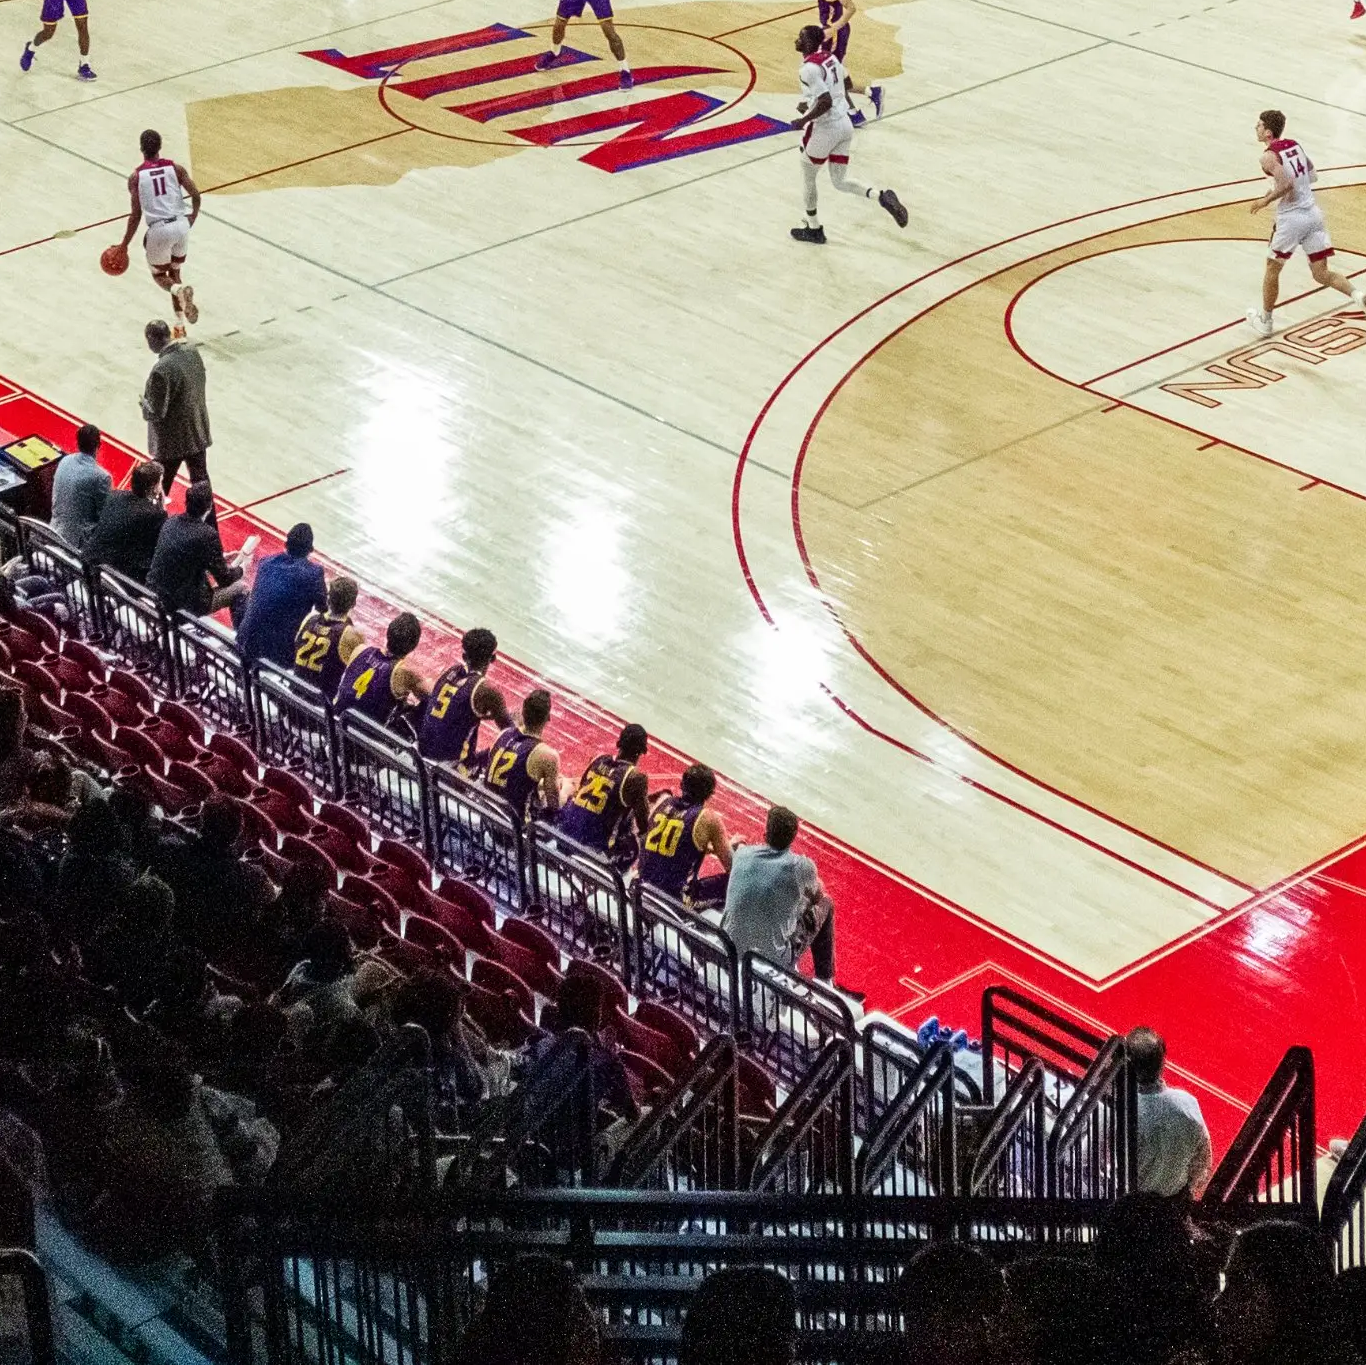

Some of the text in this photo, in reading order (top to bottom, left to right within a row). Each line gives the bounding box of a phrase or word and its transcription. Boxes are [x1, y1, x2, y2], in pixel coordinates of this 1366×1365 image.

[297, 21, 797, 174] NJIT
[152, 176, 168, 197] 11
[1289, 157, 1306, 179] 14
[295, 630, 331, 673] 22
[352, 667, 376, 701] 4
[430, 683, 459, 720] 5
[487, 747, 519, 788] 12
[573, 770, 616, 815] 25
[645, 813, 685, 858] 20
